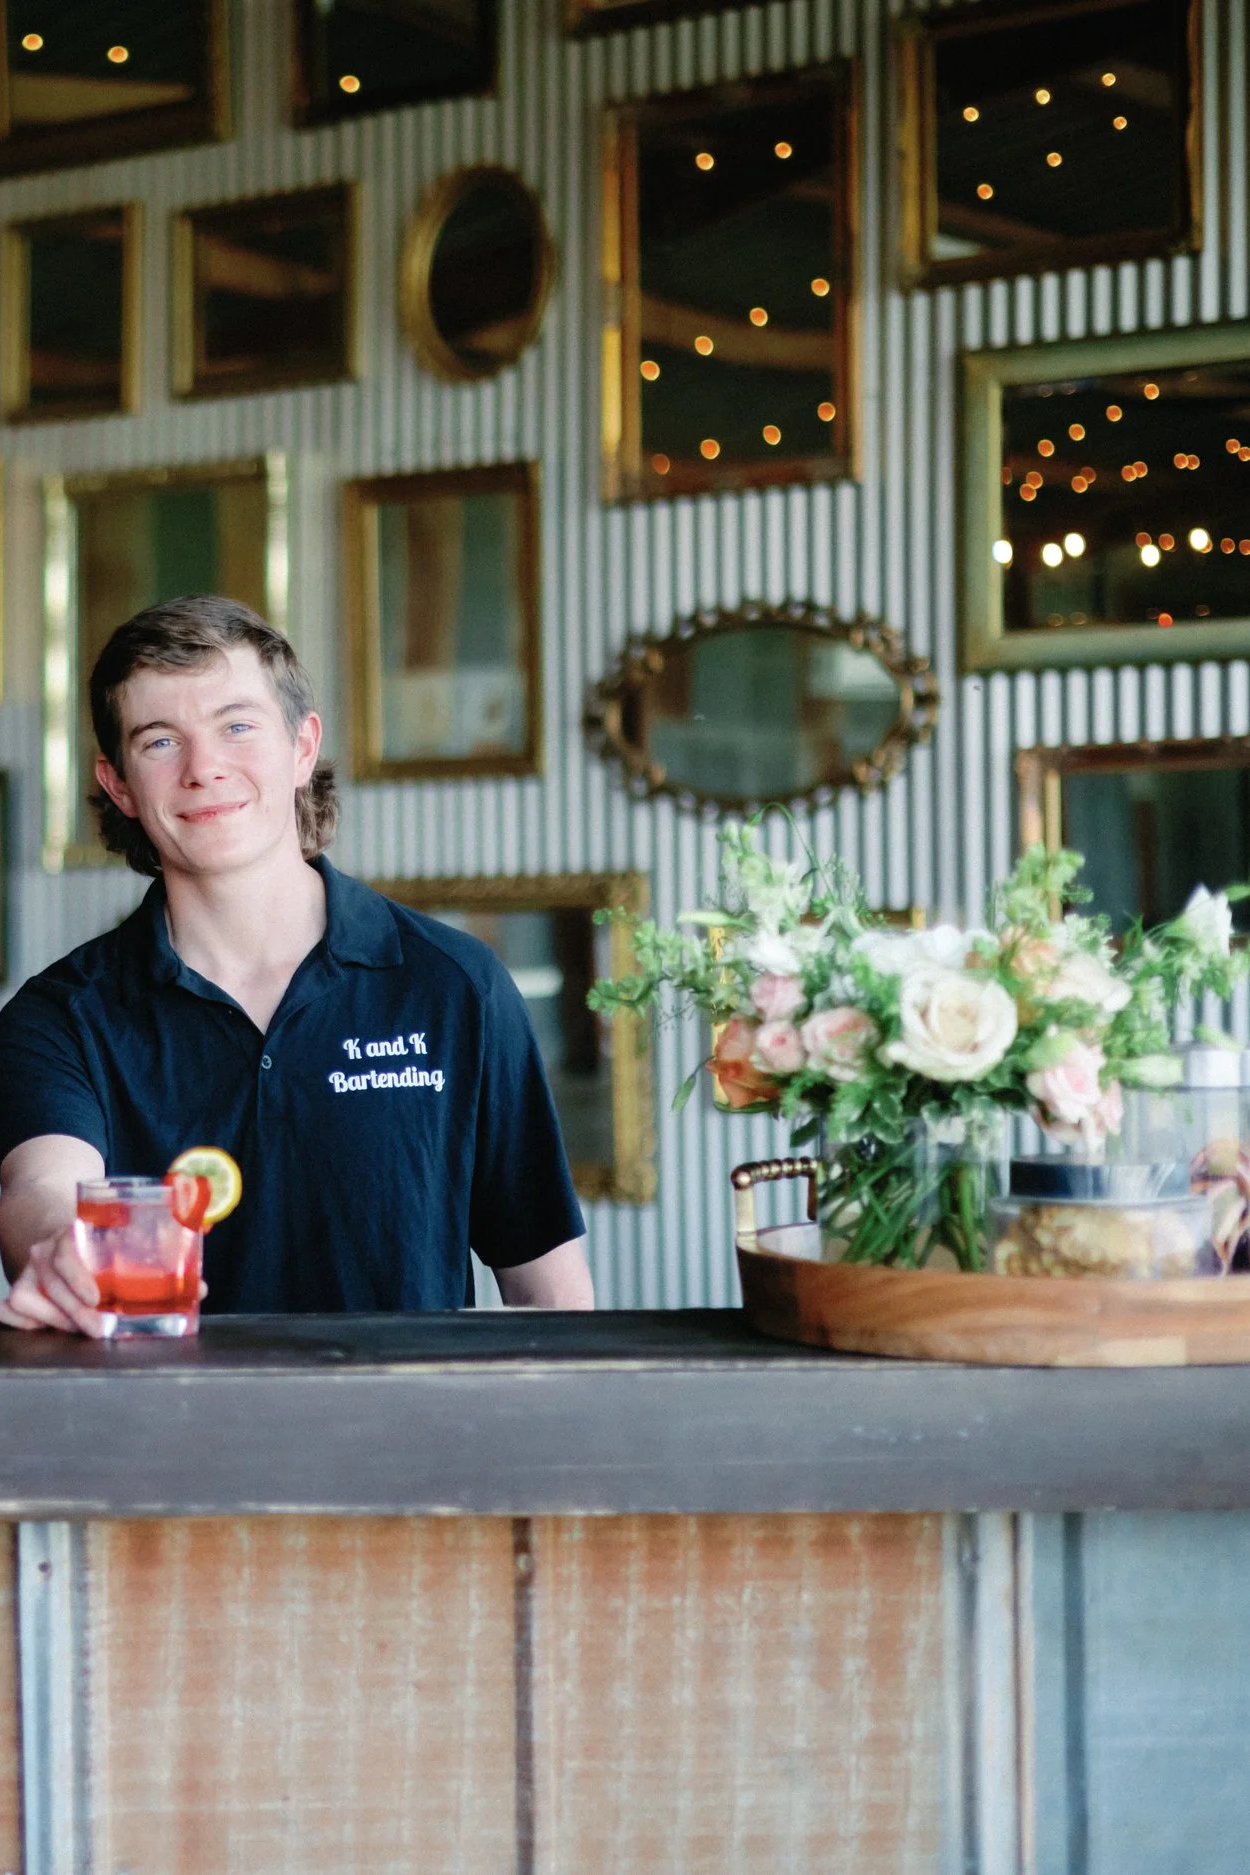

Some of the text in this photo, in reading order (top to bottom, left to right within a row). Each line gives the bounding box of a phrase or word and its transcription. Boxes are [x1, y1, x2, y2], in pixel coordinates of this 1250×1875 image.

[342, 1033, 428, 1060] K and K
[329, 1067, 445, 1092] Bartending
